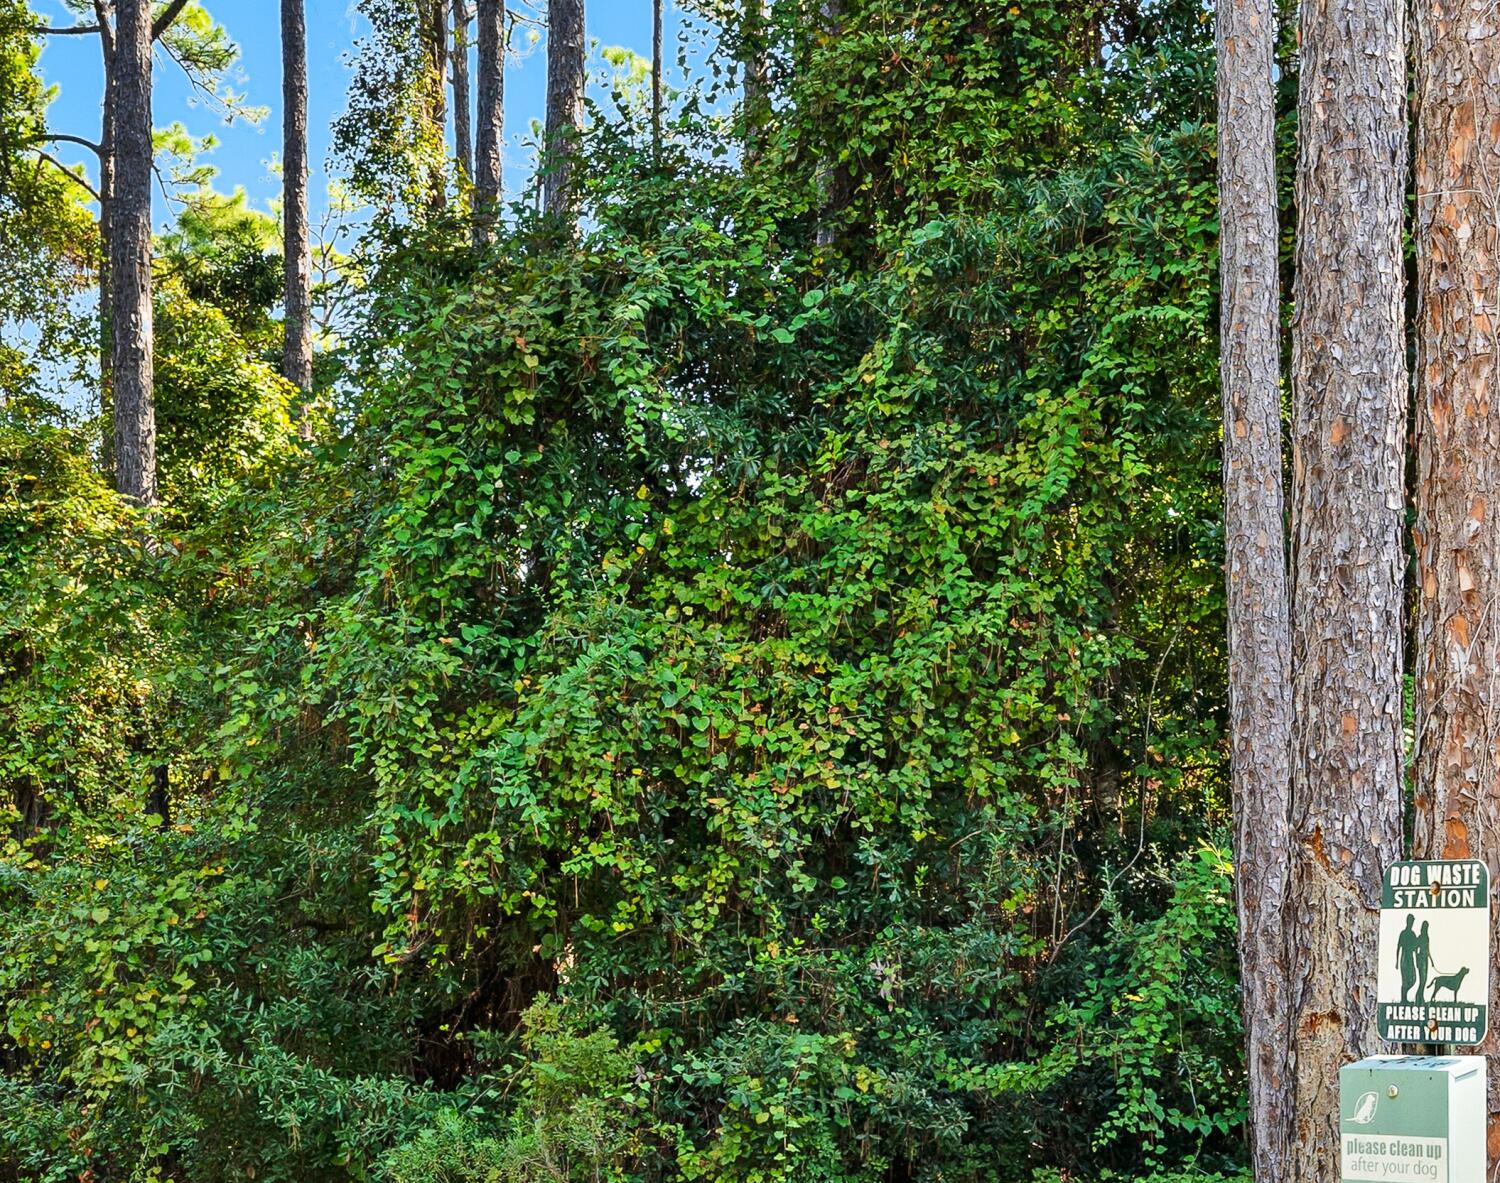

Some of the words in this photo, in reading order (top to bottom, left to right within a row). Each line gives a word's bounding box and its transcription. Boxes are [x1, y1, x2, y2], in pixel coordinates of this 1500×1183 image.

[1390, 865, 1421, 886] DOG
[1427, 864, 1480, 885] WASTE
[1393, 889, 1475, 908] STATION
[1386, 1006, 1425, 1020] PLEASE
[1428, 1007, 1461, 1022] CLEAN
[1464, 1008, 1479, 1022] UP
[1387, 1025, 1420, 1040] AFTER
[1455, 1027, 1477, 1042] DOG
[1347, 1138, 1386, 1155] please
[1390, 1140, 1423, 1157] clean
[1426, 1144, 1442, 1160] up
[1351, 1156, 1379, 1172] after
[1382, 1162, 1410, 1176] your
[1413, 1161, 1438, 1179] dog
